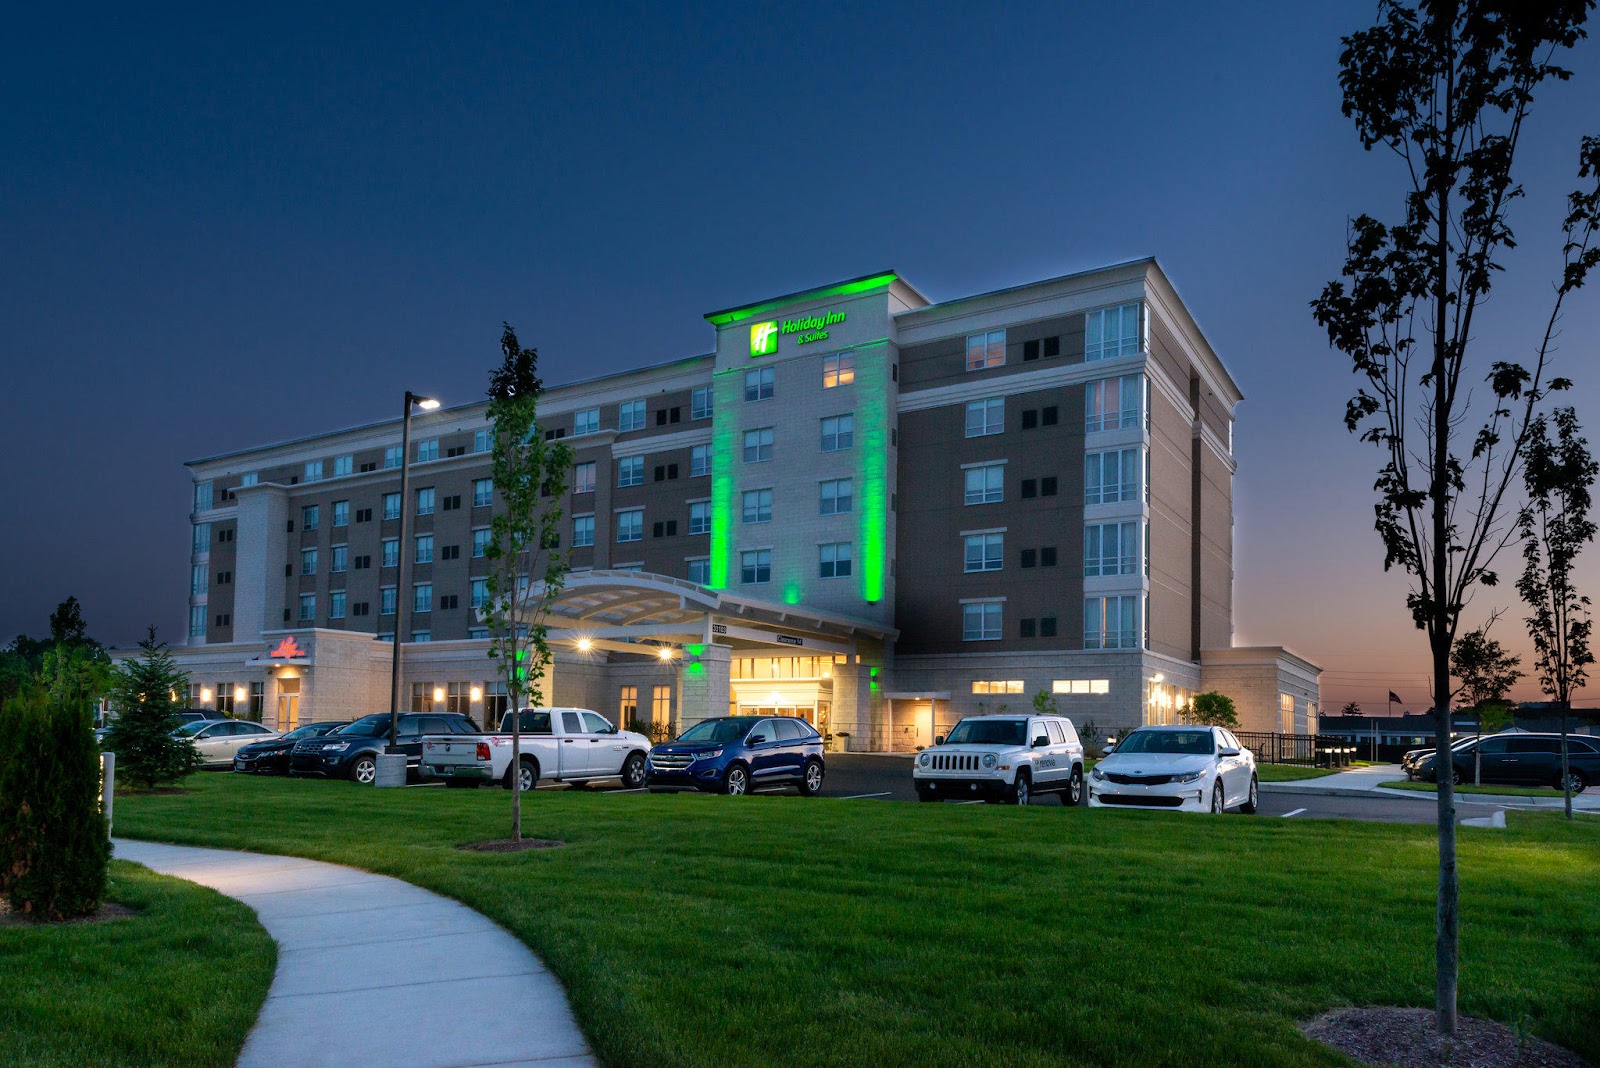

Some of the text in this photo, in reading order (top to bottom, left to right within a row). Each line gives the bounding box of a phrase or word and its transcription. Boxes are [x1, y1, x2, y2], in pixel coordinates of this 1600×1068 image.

[781, 311, 846, 334] Holiday Inn
[797, 331, 828, 344] & Suites
